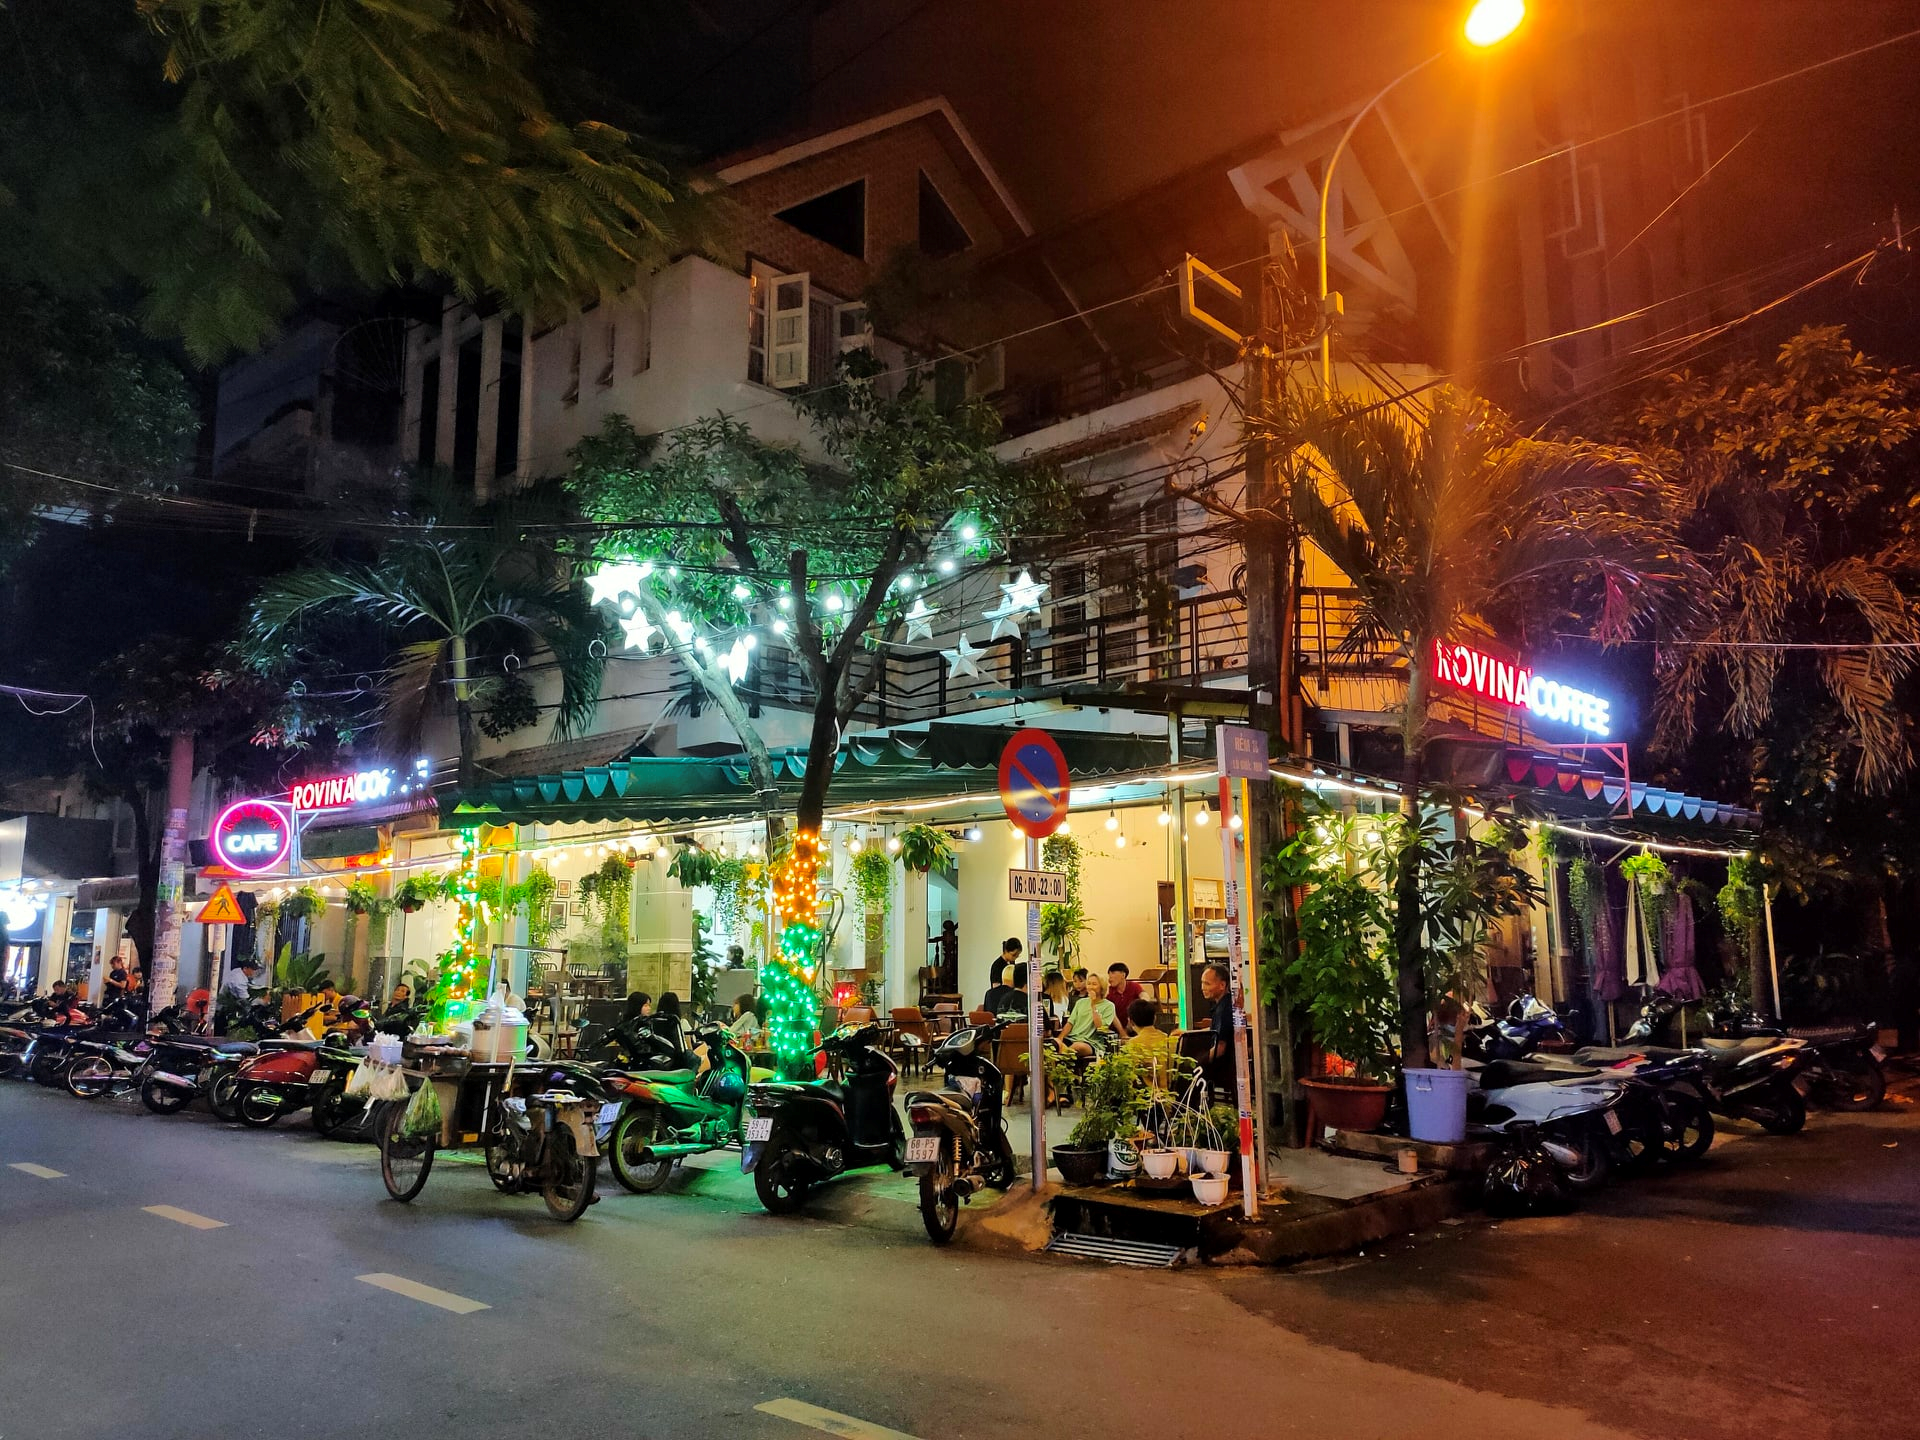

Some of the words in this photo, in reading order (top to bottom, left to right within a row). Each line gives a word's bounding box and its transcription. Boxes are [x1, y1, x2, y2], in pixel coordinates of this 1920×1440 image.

[1529, 675, 1610, 736] COFFEE
[292, 779, 355, 810] ROVINA
[222, 803, 281, 832] ROVINA
[226, 833, 279, 854] CAFE
[910, 1149, 934, 1161] 1597
